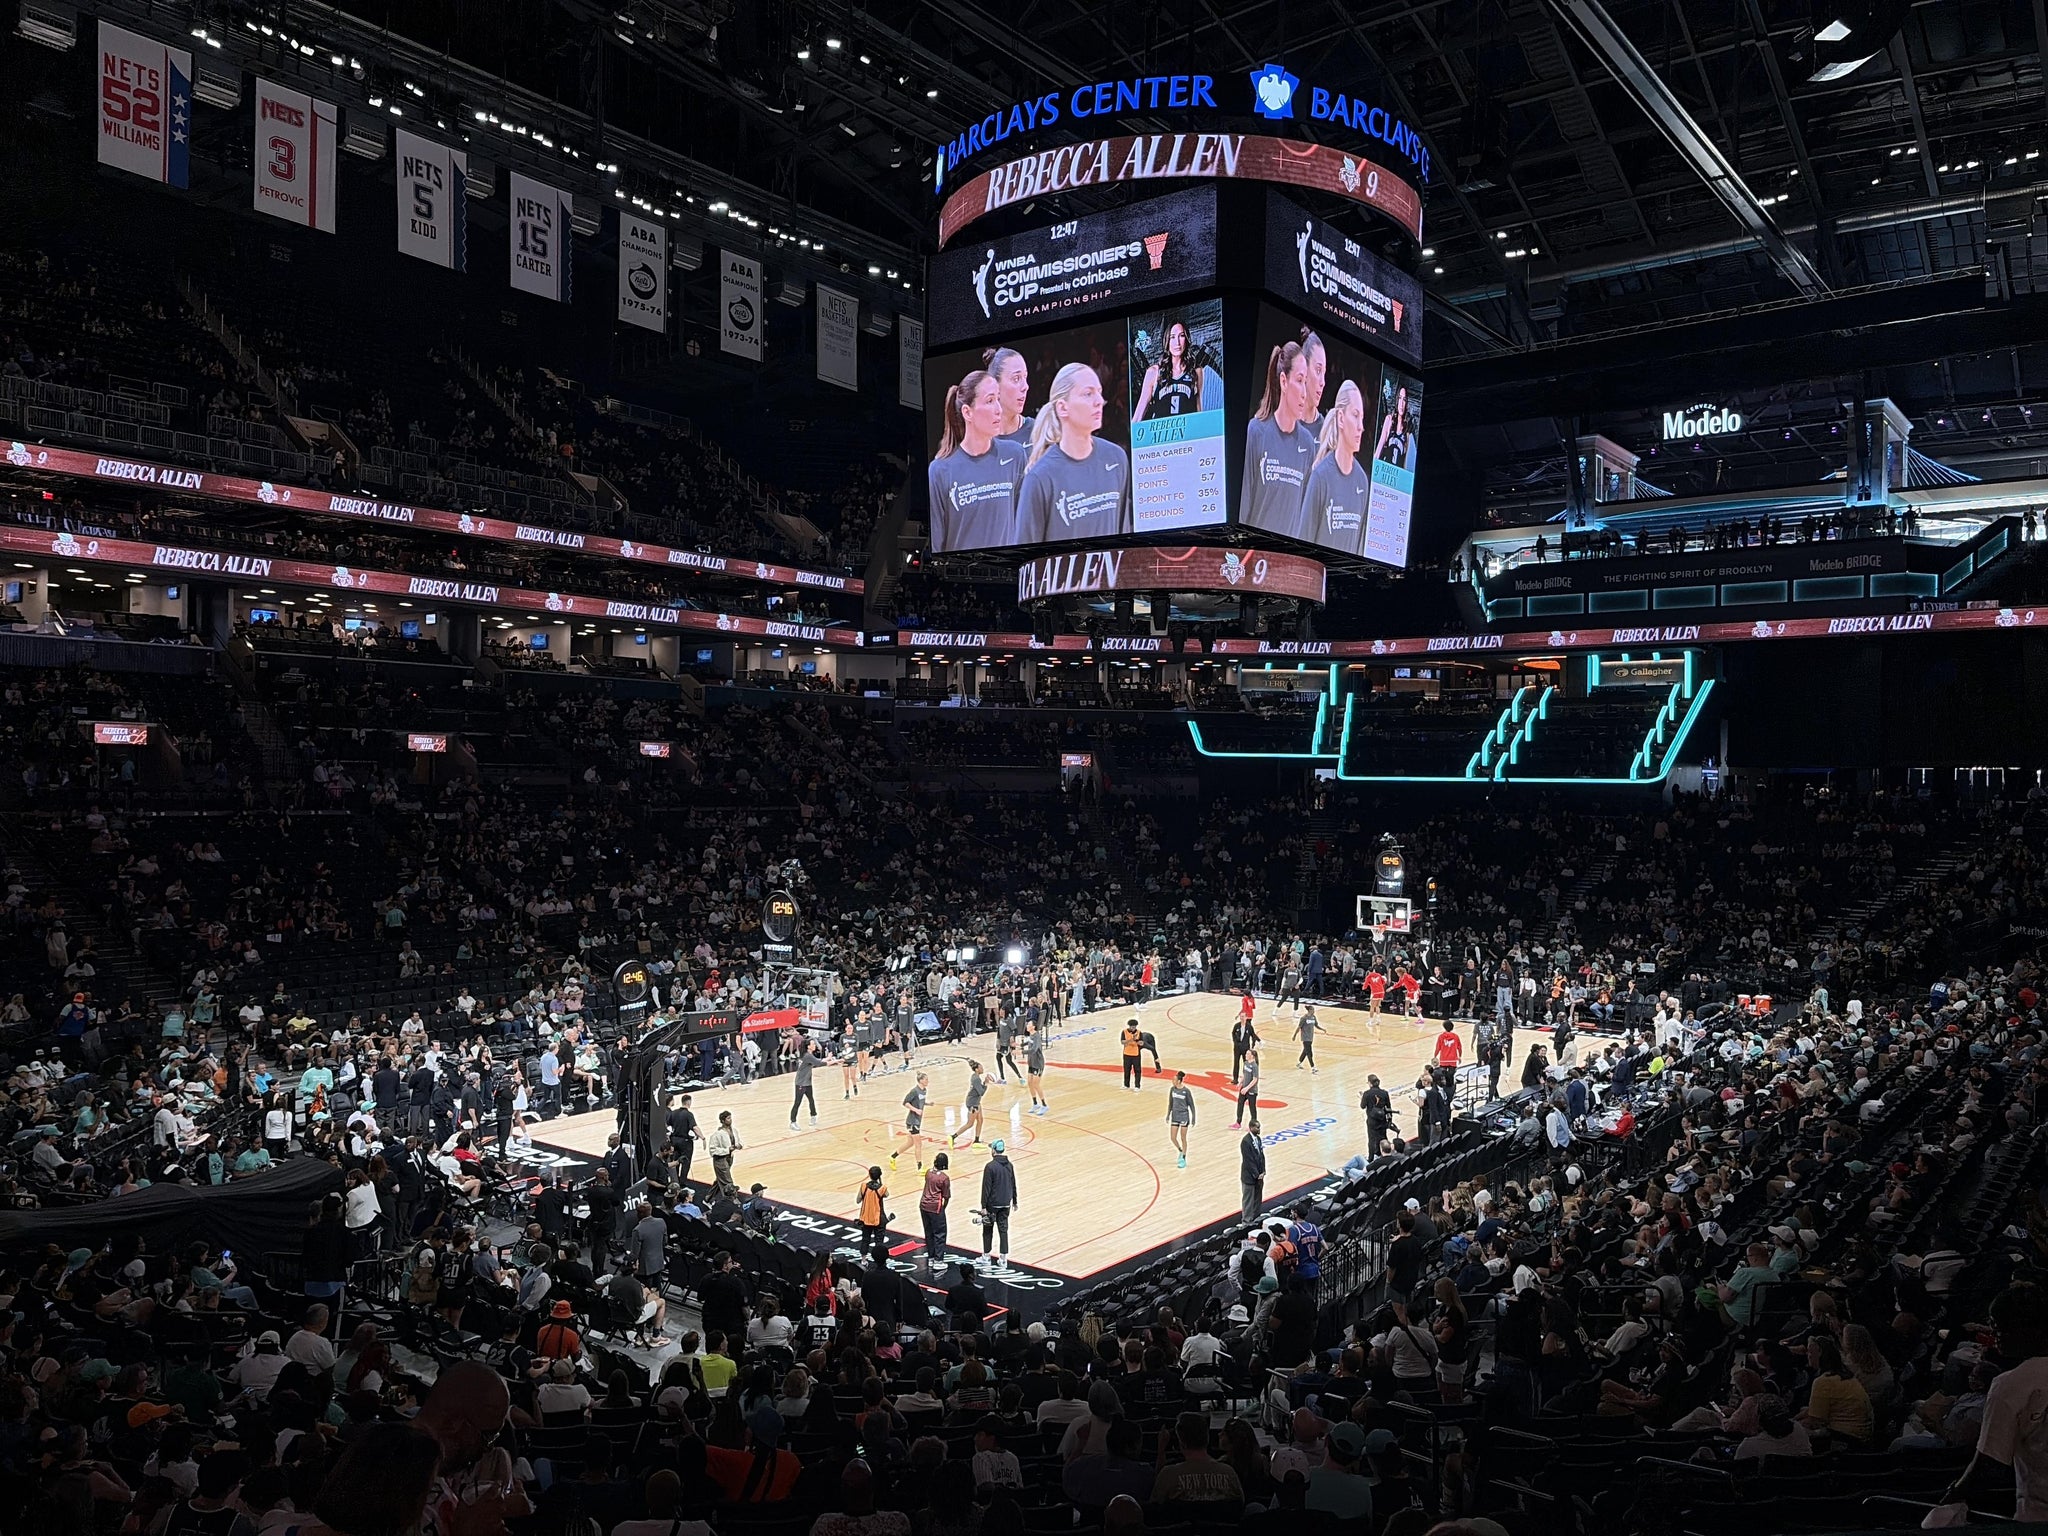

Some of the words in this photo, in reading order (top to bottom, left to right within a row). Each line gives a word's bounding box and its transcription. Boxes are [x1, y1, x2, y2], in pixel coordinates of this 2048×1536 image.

[104, 52, 159, 91] NETS
[103, 75, 160, 132] 52
[261, 96, 304, 128] NETS
[947, 93, 1060, 172] BARCLAYS
[1070, 75, 1217, 118] CENTER
[1311, 87, 1420, 165] BARCLAYS
[103, 118, 160, 151] WILLIAMS
[268, 135, 296, 182] 3
[403, 155, 442, 191] NETS
[984, 141, 1111, 213] REBECCA
[1116, 134, 1245, 178] ALLEN
[1365, 171, 1379, 197] 9
[259, 184, 304, 207] PETROVIC
[413, 182, 433, 222] 5
[516, 197, 552, 229] NETS
[410, 218, 437, 240] KIDD
[630, 226, 657, 245] ABA
[1050, 221, 1077, 240] 12:47
[519, 220, 549, 259] 15
[621, 240, 662, 260] CHAMPIONS
[1311, 239, 1337, 263] WNBA
[516, 253, 552, 277] CARTER
[730, 262, 754, 279] ABA
[994, 241, 1142, 289] COMMISSIONER'S
[995, 254, 1036, 272] WNBA
[994, 283, 1038, 306] CUP
[1072, 266, 1129, 289] coinbase
[1311, 254, 1391, 312] COMMISSIONER'S
[622, 297, 662, 316] 1975-76
[828, 295, 847, 315] NETS
[1015, 289, 1112, 317] CHAMPIONSHIP
[1311, 271, 1338, 296] CUP
[1356, 301, 1385, 324] coinbase
[821, 307, 855, 329] BASKETBALL
[1323, 301, 1377, 334] CHAMPIONSHIP
[724, 329, 759, 346] 1973-74
[909, 326, 922, 342] NET
[1686, 403, 1717, 414] CERVEZA
[1149, 417, 1186, 432] REBECCA
[1663, 408, 1742, 440] Modelo
[1136, 428, 1144, 441] 9
[1151, 427, 1186, 444] ALLEN
[37, 451, 48, 465] 9
[1138, 451, 1161, 460] WNBA
[1163, 447, 1193, 457] CAREER
[95, 458, 156, 484] REBECCA
[157, 469, 203, 490] ALLEN
[1138, 464, 1167, 475] GAMES
[1199, 457, 1216, 467] 267
[1138, 479, 1169, 490] POINTS
[1201, 473, 1215, 482] 5.7
[282, 490, 291, 502] 9
[959, 495, 978, 506] CUP
[1138, 493, 1172, 505] 3-POINT
[1173, 492, 1185, 501] FG
[1198, 488, 1219, 497] 35%
[329, 496, 377, 516] REBECCA
[378, 504, 415, 522] ALLEN
[1069, 508, 1089, 520] CUP
[1139, 508, 1184, 519] REBOUNDS
[1202, 503, 1216, 512] 2.6
[477, 521, 485, 532] 9
[515, 525, 554, 544] REBECCA
[555, 532, 585, 548] ALLEN
[87, 540, 98, 555] 9
[636, 546, 643, 556] 9
[152, 546, 220, 572] REBECCA
[222, 556, 272, 576] ALLEN
[668, 550, 701, 566] REBECCA
[701, 556, 727, 571] ALLEN
[1809, 557, 1844, 572] Modelo
[1845, 554, 1882, 569] BRIDGE
[358, 573, 367, 586] 9
[795, 571, 824, 586] REBECCA
[824, 576, 845, 589] ALLEN
[1038, 550, 1123, 595] ALLEN
[1253, 560, 1267, 584] 9
[1603, 573, 1621, 583] THE
[1623, 571, 1667, 582] FIGHTING
[1669, 569, 1701, 581] SPIRIT
[1703, 568, 1717, 578] OF
[1719, 564, 1773, 577] BROOKLYN
[408, 577, 459, 598] REBECCA
[461, 584, 500, 602] ALLEN
[1515, 578, 1542, 591] Modelo
[1543, 576, 1572, 590] BRIDGE
[566, 598, 574, 610] 9
[606, 601, 648, 619] REBECCA
[649, 607, 680, 624] ALLEN
[733, 618, 740, 630] 9
[1828, 616, 1884, 634] REBECCA
[1887, 614, 1934, 630] ALLEN
[2024, 610, 2035, 623] 9
[765, 621, 800, 638] REBECCA
[800, 626, 826, 640] ALLEN
[1611, 628, 1660, 643] REBECCA
[1661, 624, 1700, 641] ALLEN
[1776, 622, 1785, 635] 9
[910, 632, 952, 646] REBECCA
[953, 634, 987, 647] ALLEN
[1129, 638, 1161, 651] ALLEN
[1220, 641, 1227, 651] 9
[1299, 642, 1332, 654] ALLEN
[1389, 641, 1397, 651] 9
[1427, 636, 1468, 651] REBECCA
[1469, 633, 1504, 649] ALLEN
[1568, 633, 1577, 644] 9
[1630, 665, 1673, 677] Gallagher
[772, 901, 793, 915] 12:46
[623, 971, 643, 984] 12:46
[1261, 1117, 1337, 1148] coinbas
[813, 1327, 830, 1341] 23
[1178, 1474, 1202, 1490] NEW
[1204, 1474, 1231, 1490] YORK
